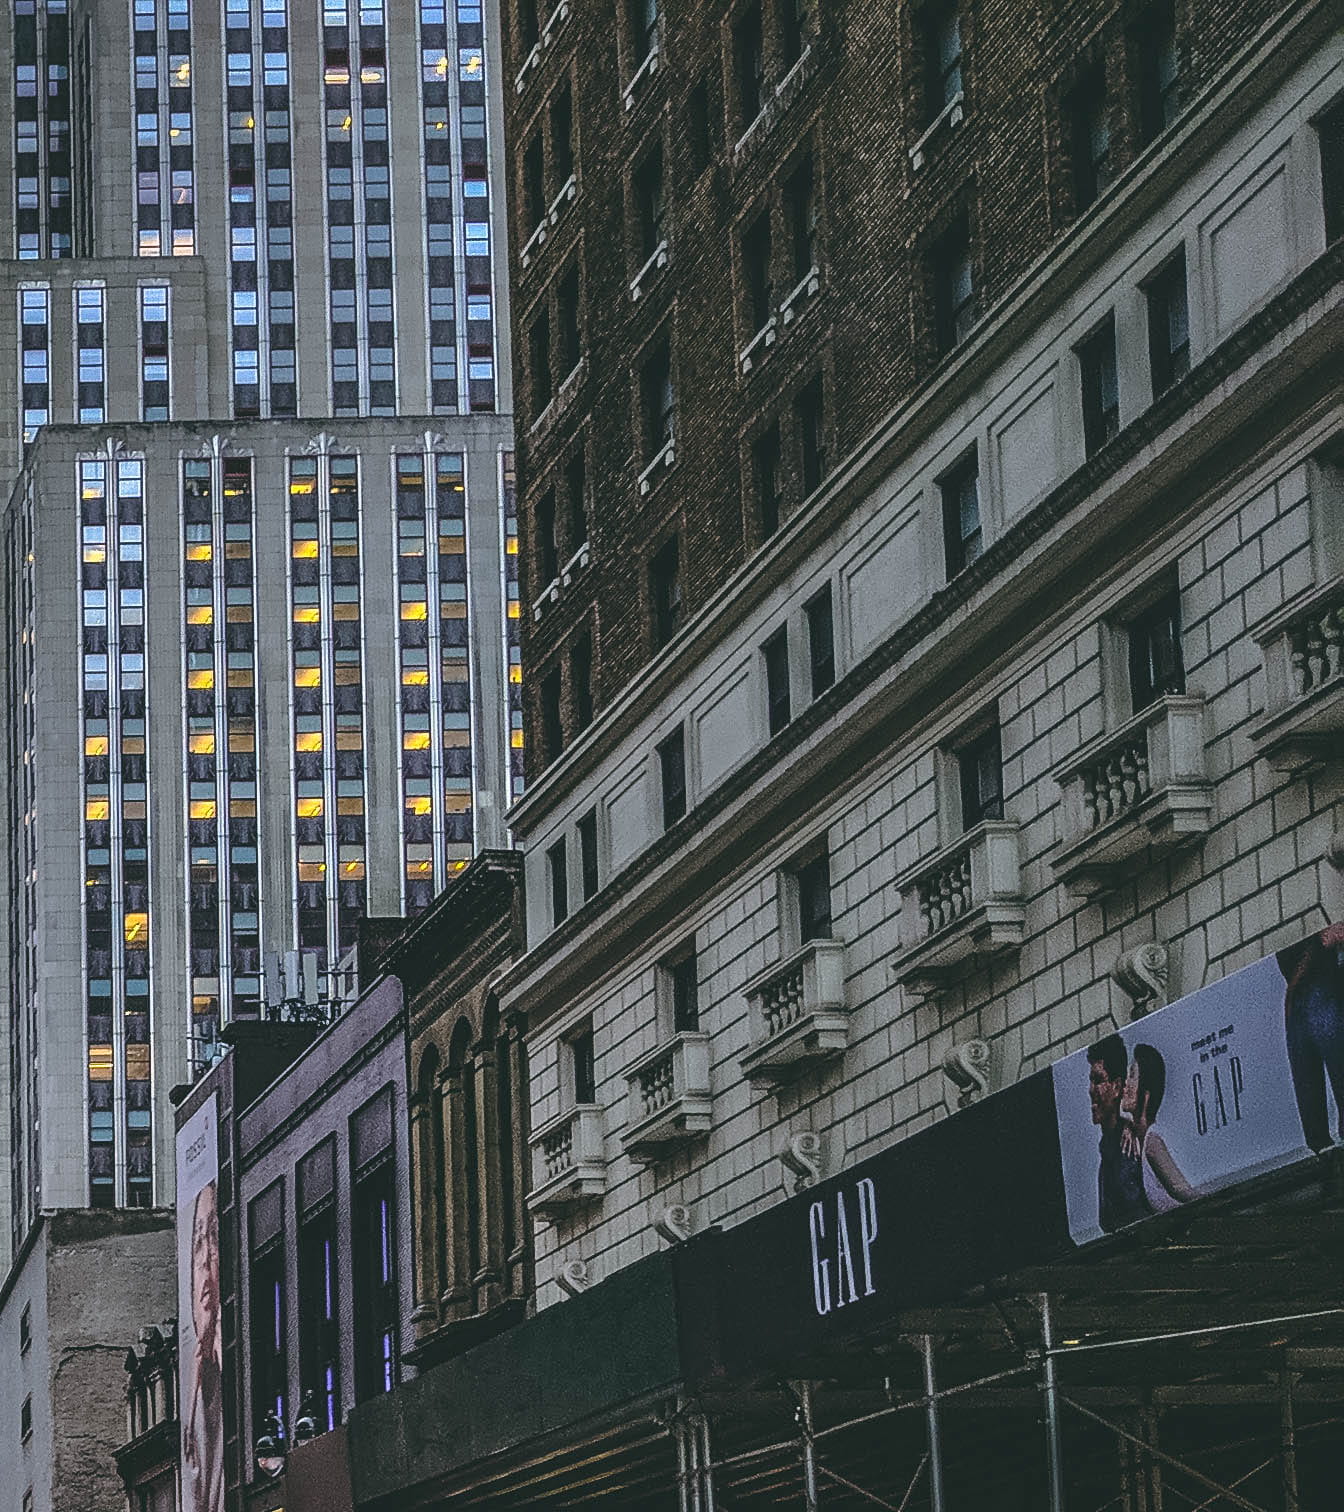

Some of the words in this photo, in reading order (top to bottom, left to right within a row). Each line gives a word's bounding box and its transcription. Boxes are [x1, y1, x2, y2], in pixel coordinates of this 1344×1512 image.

[1191, 1031, 1217, 1051] meet
[1218, 1024, 1234, 1039] me
[1199, 1052, 1210, 1063] in
[1210, 1043, 1228, 1058] the
[1192, 1056, 1244, 1136] GAP
[808, 1177, 878, 1315] GAP
